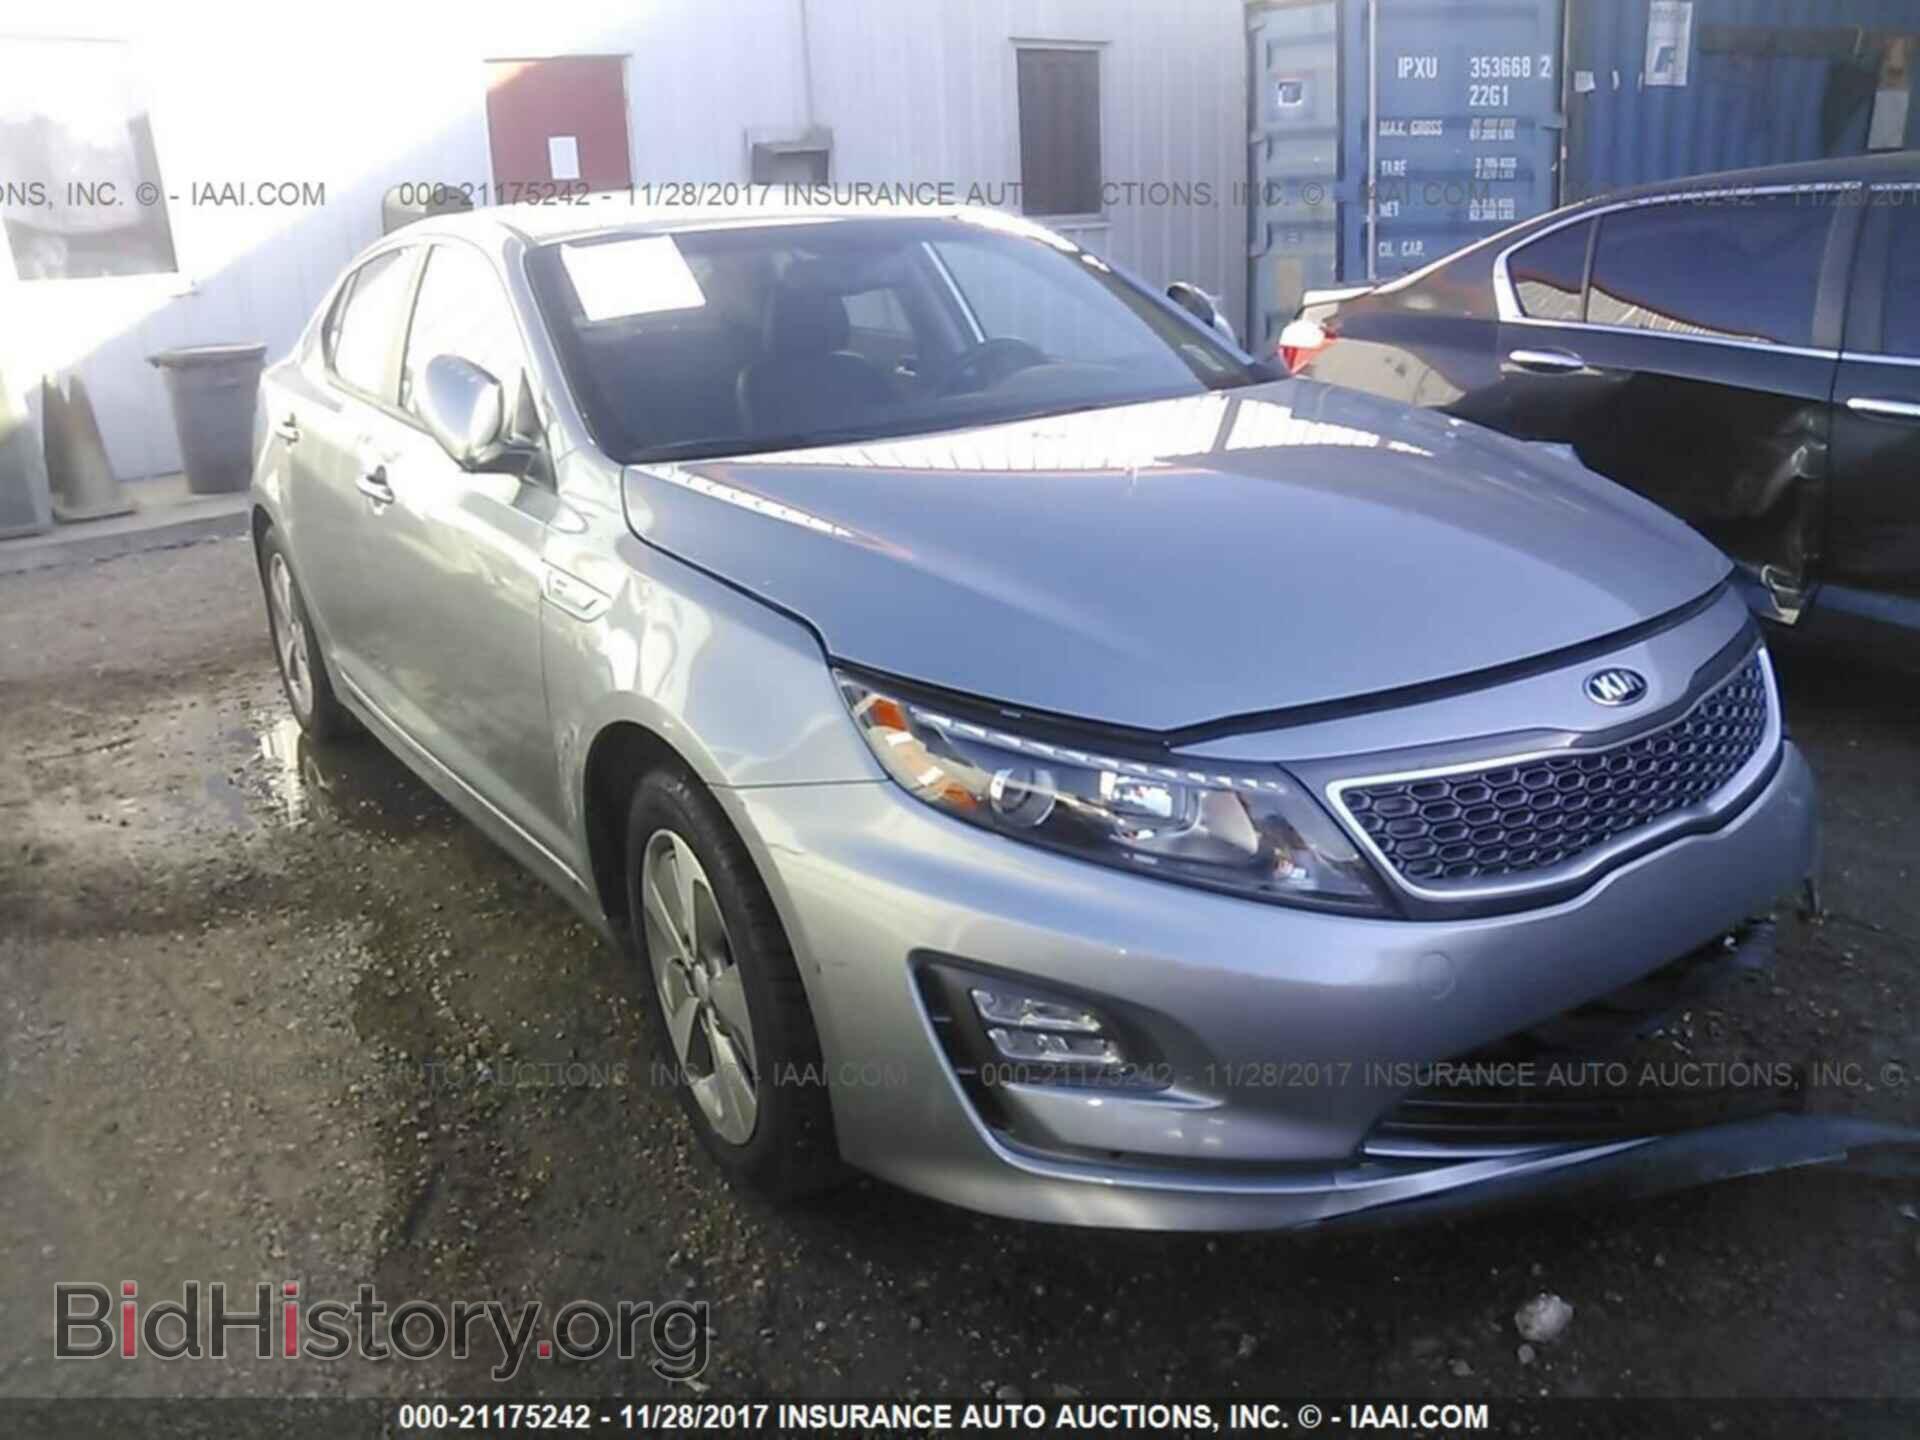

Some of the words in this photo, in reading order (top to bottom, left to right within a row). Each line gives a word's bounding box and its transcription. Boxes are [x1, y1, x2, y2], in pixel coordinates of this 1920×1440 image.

[1398, 56, 1438, 79] IPXU
[1469, 56, 1531, 79] 353668
[1469, 84, 1509, 106] 22G1
[1380, 201, 1399, 217] NET
